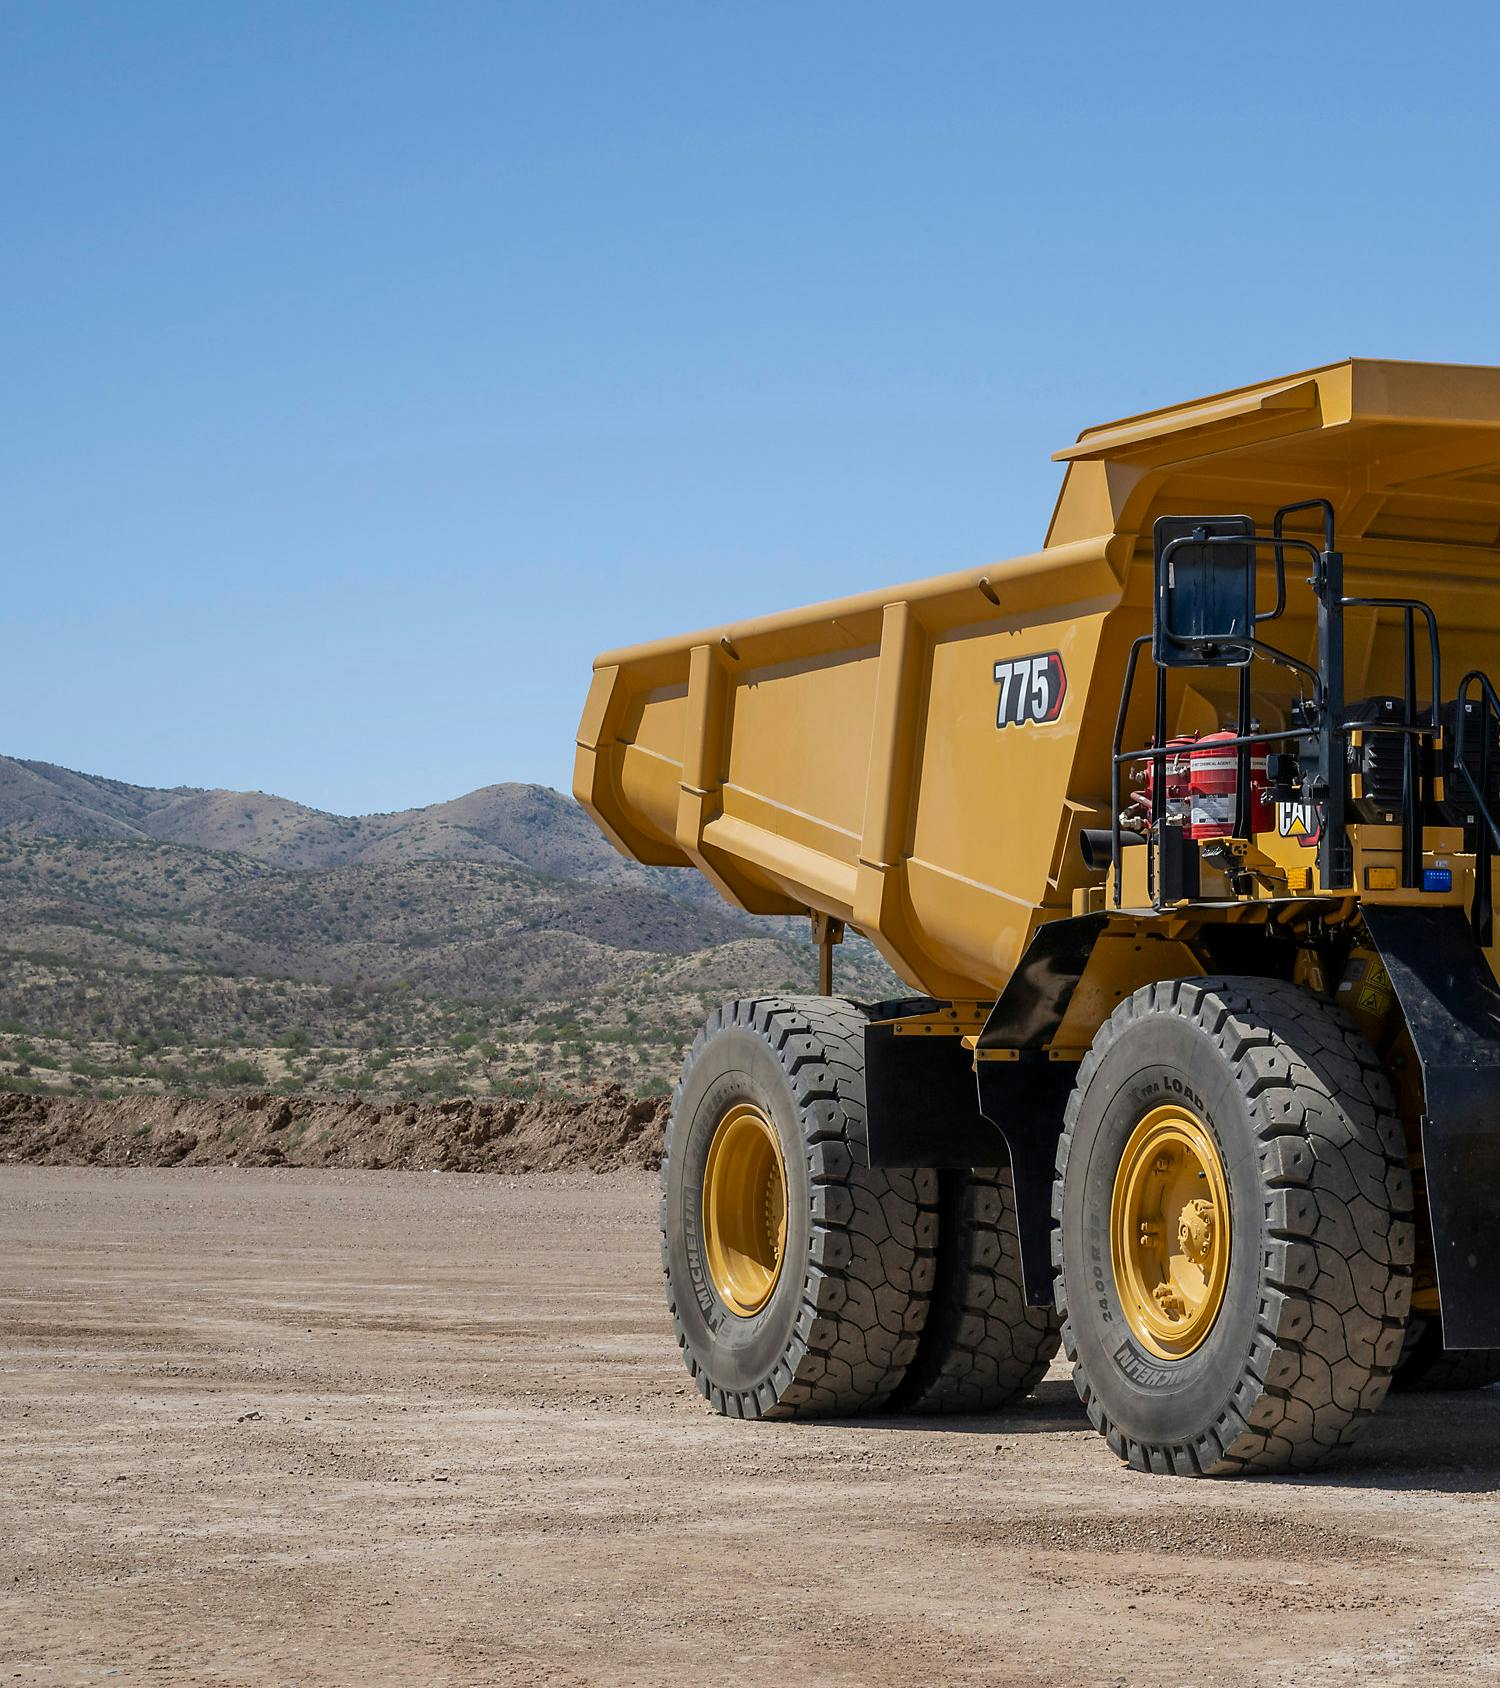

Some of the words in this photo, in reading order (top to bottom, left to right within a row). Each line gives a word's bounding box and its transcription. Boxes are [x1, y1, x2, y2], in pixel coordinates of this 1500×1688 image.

[996, 657, 1049, 724] 775
[1163, 1076, 1204, 1111] LOAD
[685, 1190, 712, 1312] MICHELIN
[1116, 1346, 1188, 1387] MICHELIN
